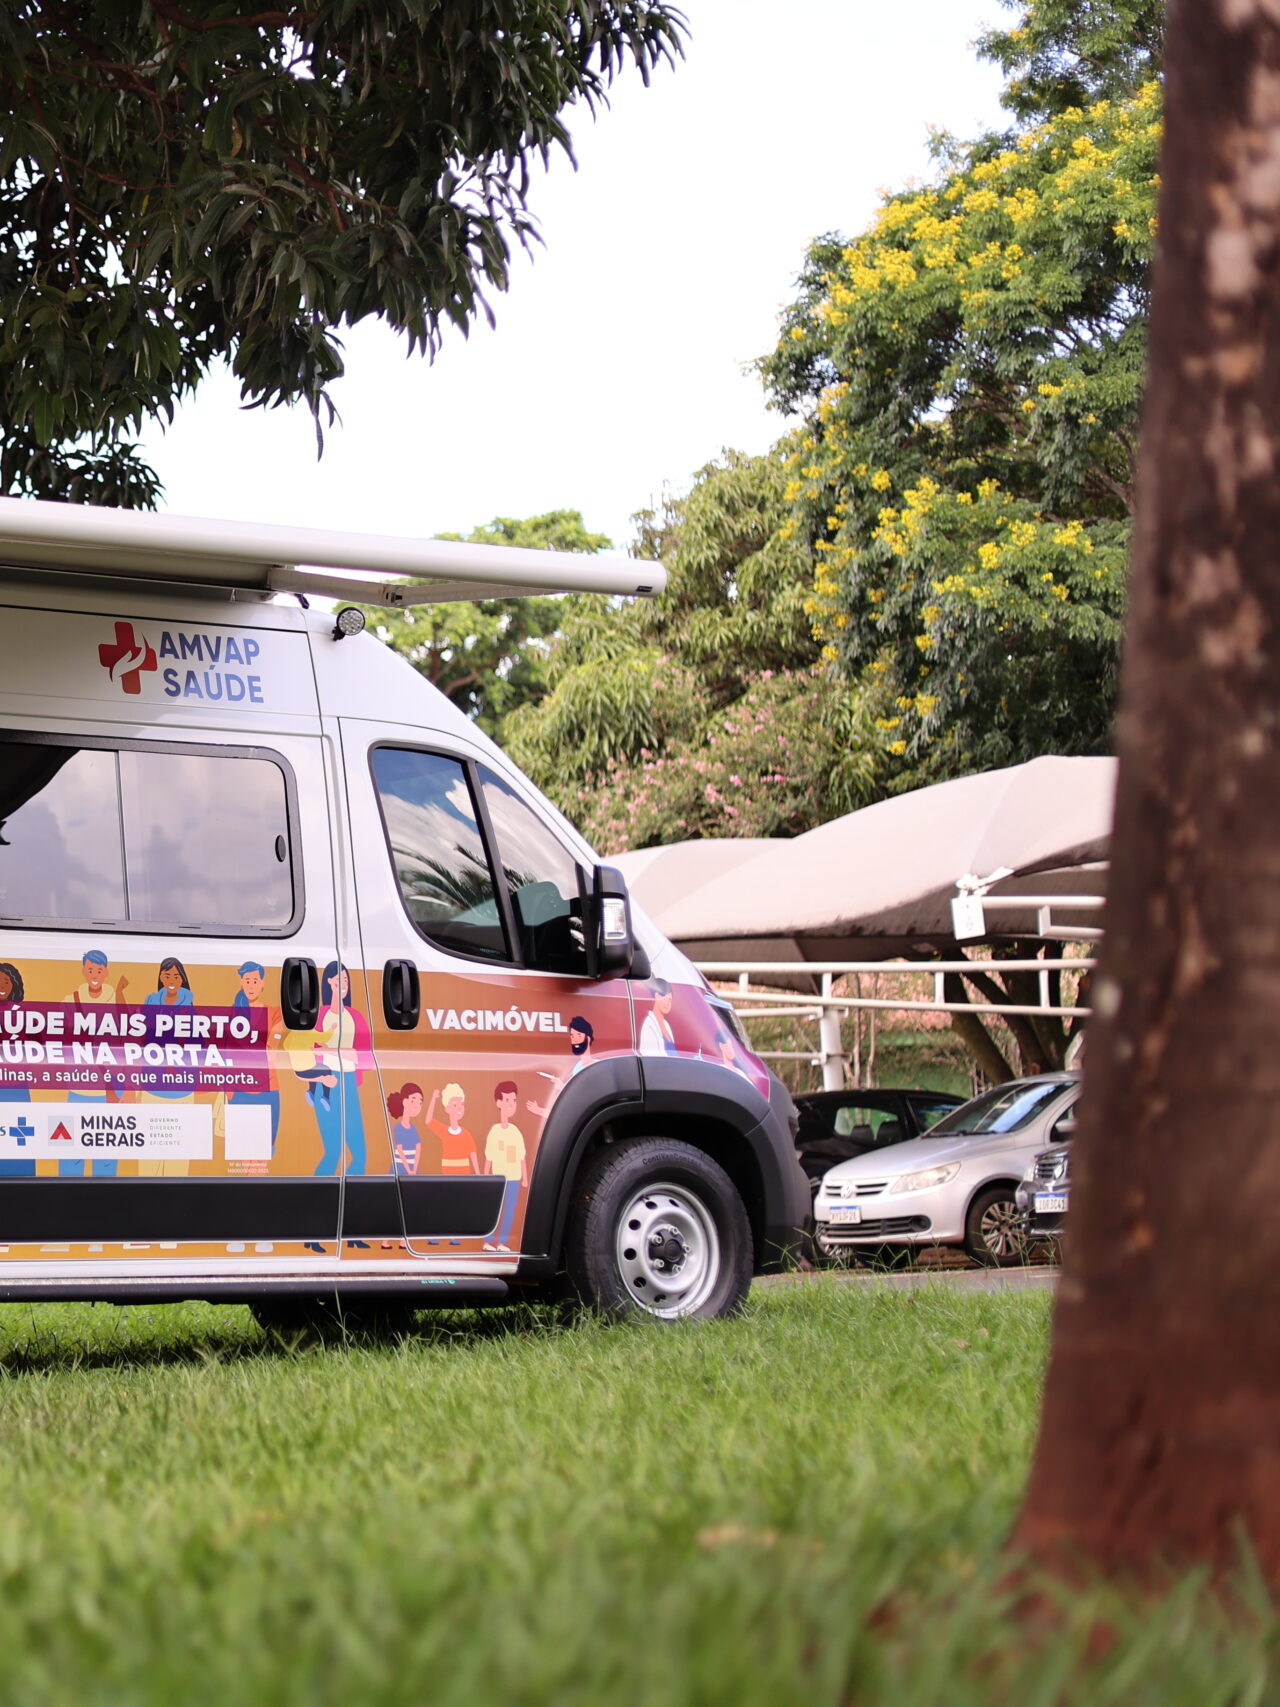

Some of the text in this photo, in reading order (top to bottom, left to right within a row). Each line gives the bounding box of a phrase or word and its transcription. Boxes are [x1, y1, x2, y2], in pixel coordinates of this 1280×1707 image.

[159, 631, 260, 666] AMVAP
[163, 665, 264, 703] SAÚDE
[73, 1012, 147, 1037] MAIS
[155, 1015, 259, 1043] PERTO,
[426, 1005, 568, 1033] VACIMÓVEL
[72, 1041, 118, 1065] NA
[124, 1043, 234, 1067] PORTA.
[42, 1072, 51, 1082] a
[55, 1069, 99, 1083] saúde
[103, 1069, 112, 1083] é
[116, 1073, 126, 1083] o
[130, 1073, 158, 1087] que
[162, 1070, 195, 1084] mais
[198, 1071, 259, 1087] importa.
[81, 1115, 137, 1130] MINAS
[80, 1132, 145, 1147] GERAIS
